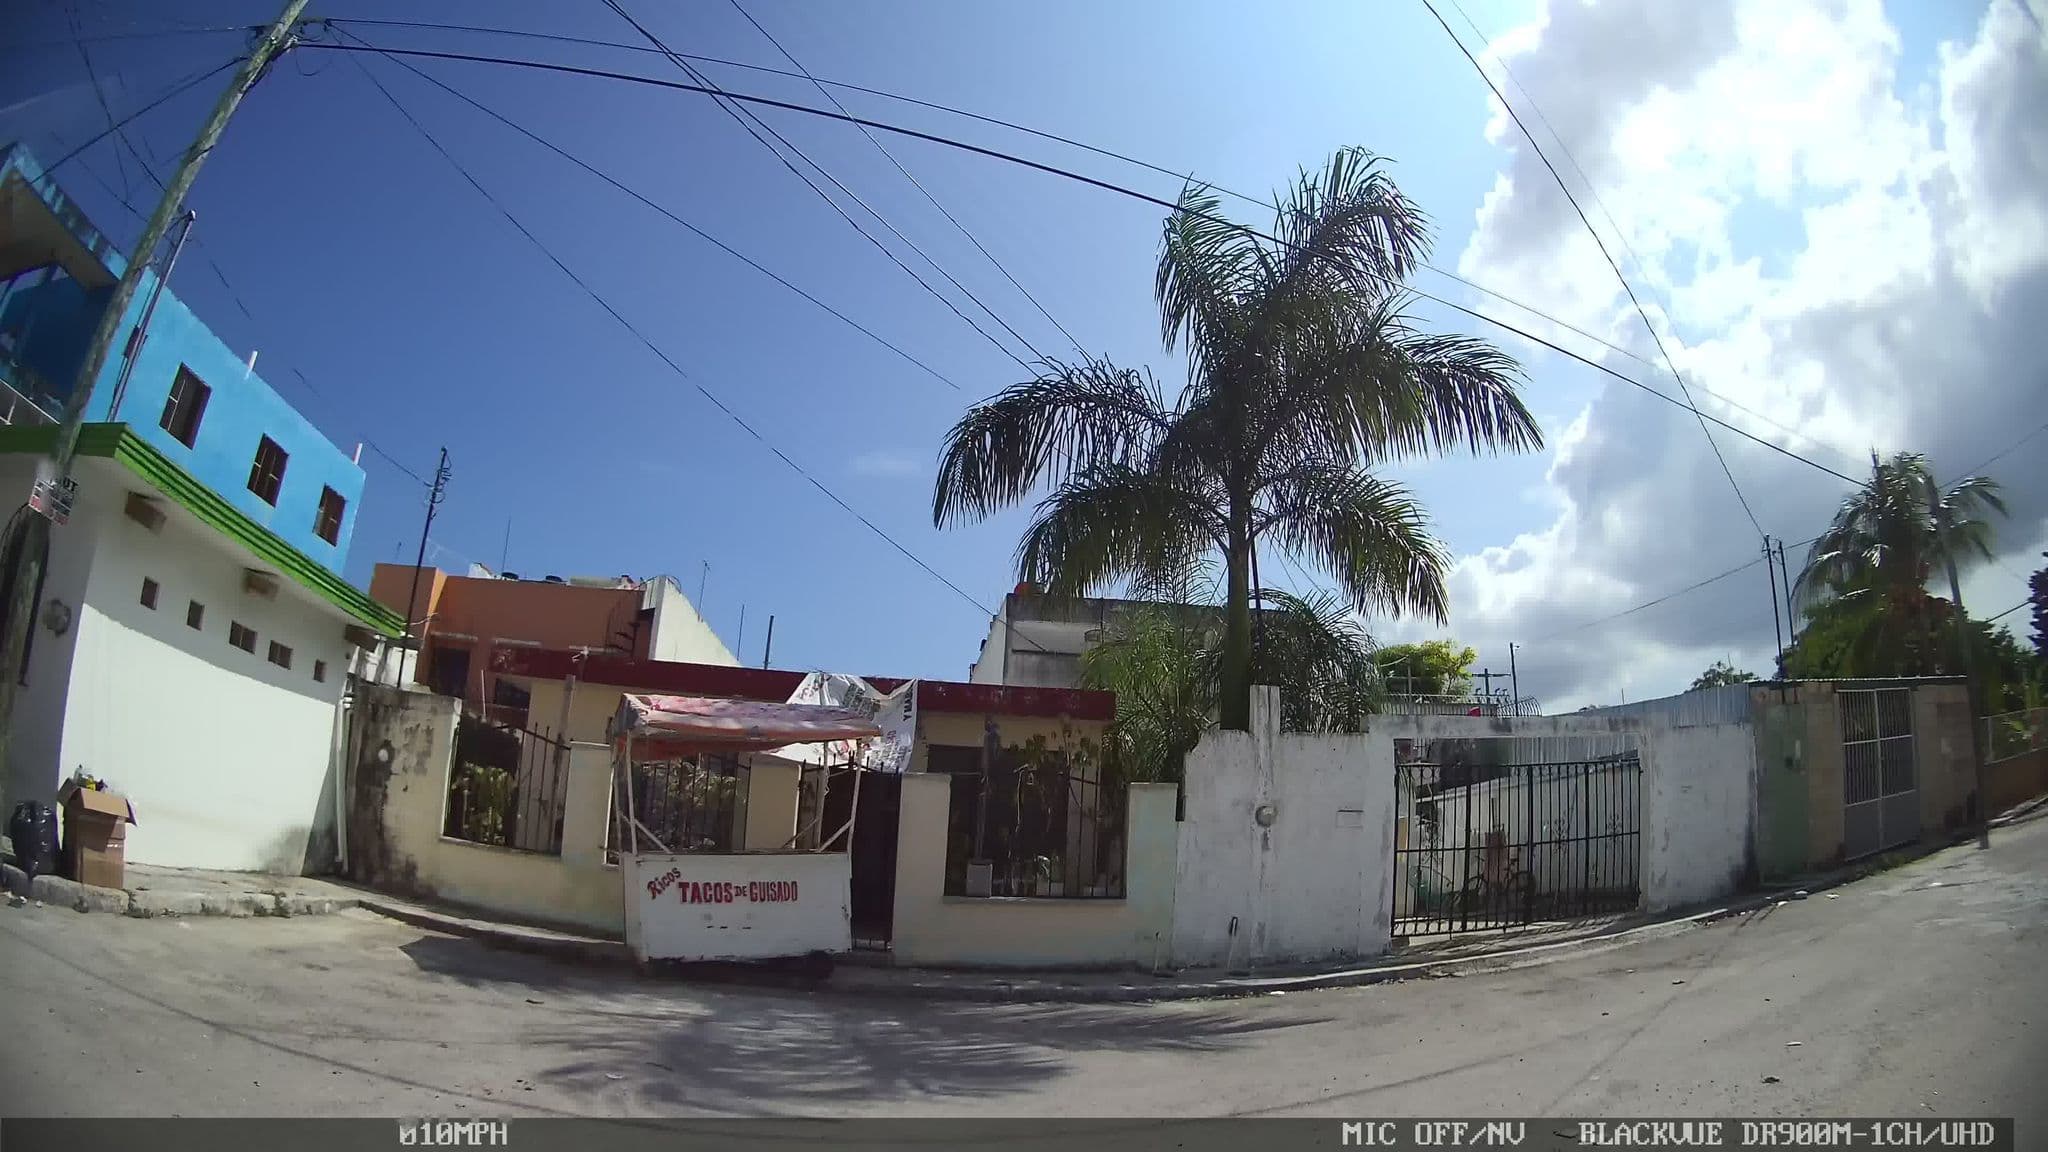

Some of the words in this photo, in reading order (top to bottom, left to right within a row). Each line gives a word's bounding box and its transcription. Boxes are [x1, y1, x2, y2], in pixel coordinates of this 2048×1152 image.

[678, 881, 734, 904] TACOS
[734, 885, 748, 898] DE
[749, 880, 798, 903] GUISADO
